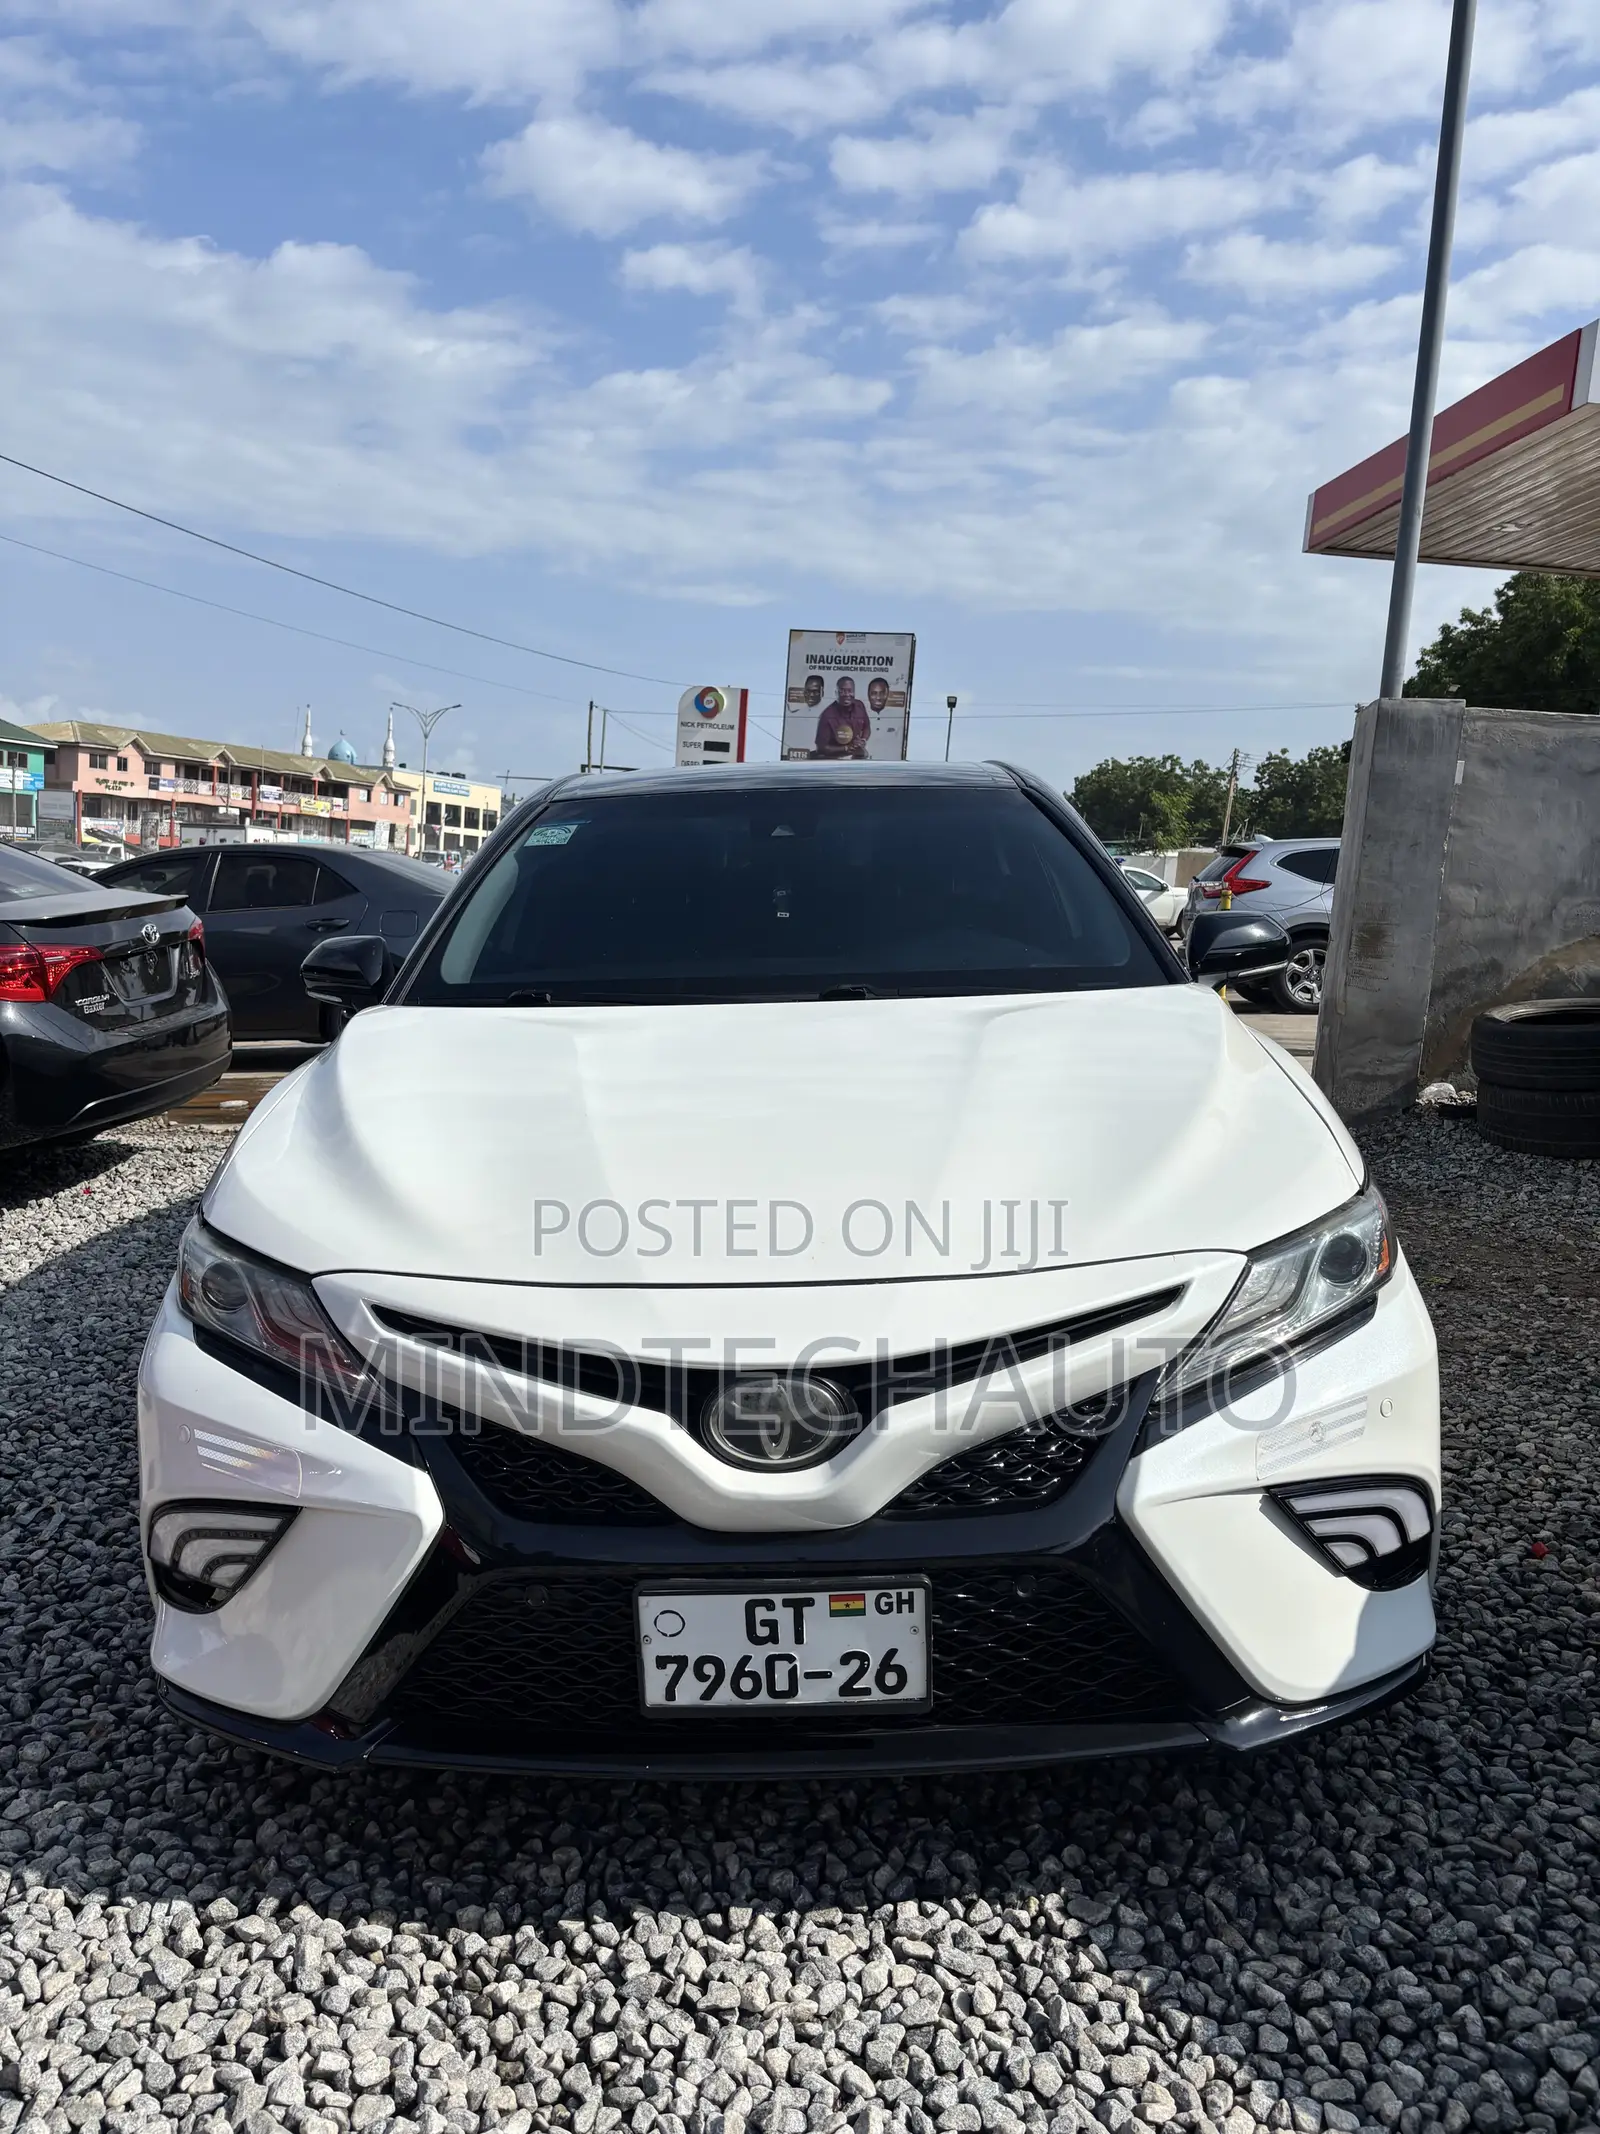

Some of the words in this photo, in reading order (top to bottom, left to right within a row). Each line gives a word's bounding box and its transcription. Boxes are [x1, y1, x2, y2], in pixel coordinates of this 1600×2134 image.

[805, 654, 894, 667] INAUGURATION
[696, 722, 735, 730] PETROLEUM
[682, 741, 702, 749] SUPER
[744, 1597, 815, 1646] GT
[874, 1591, 915, 1615] GH
[655, 1647, 908, 1702] 7960-26
